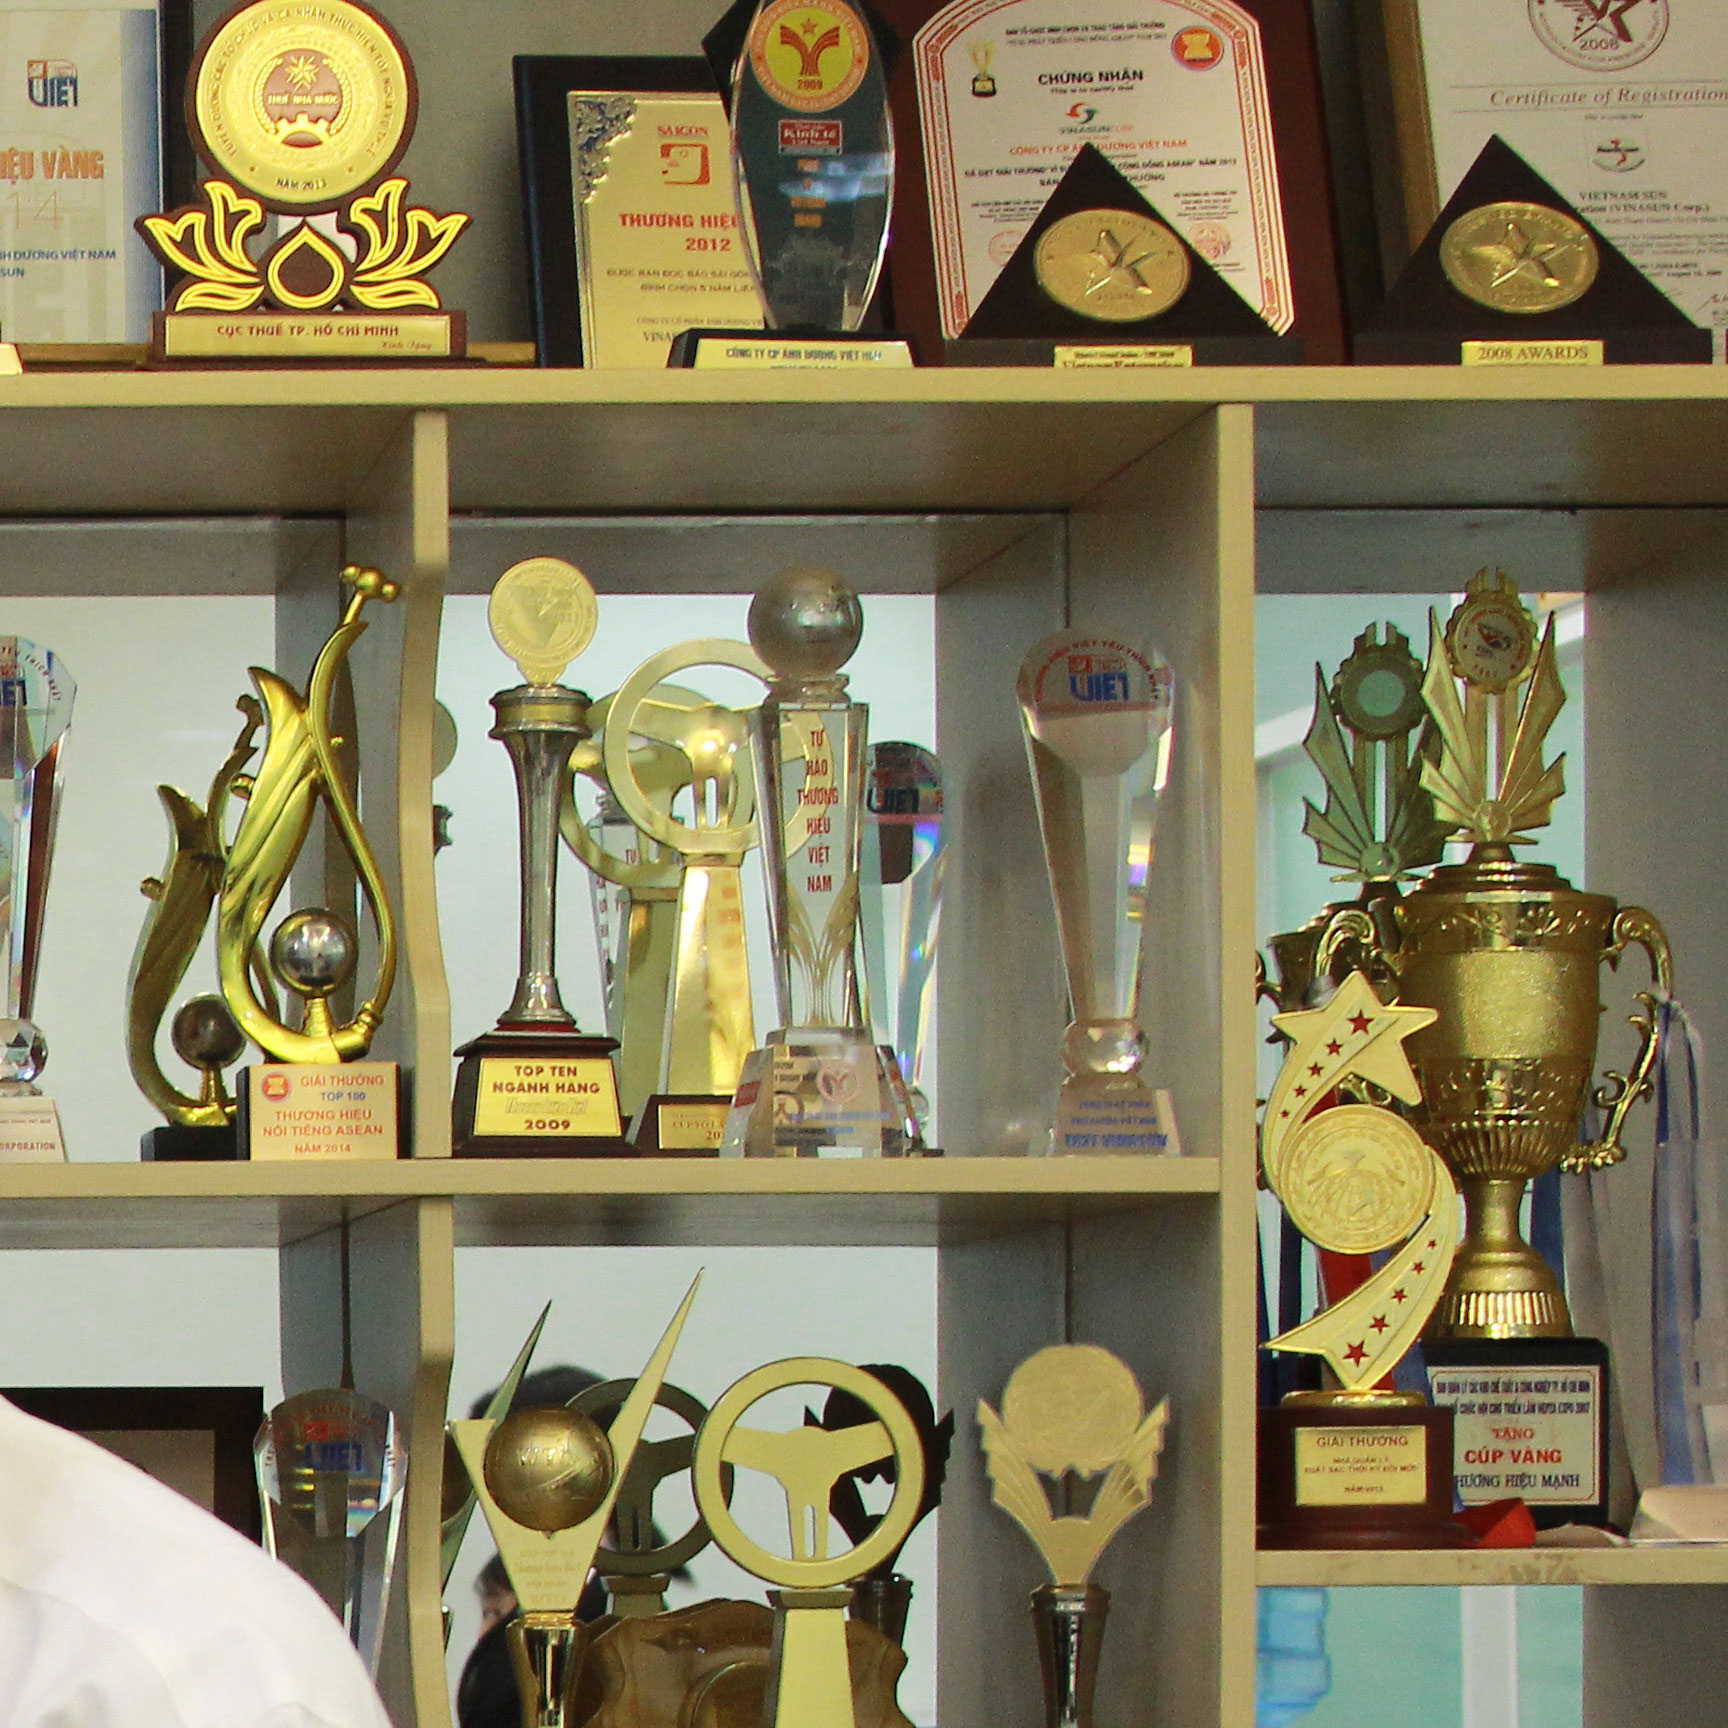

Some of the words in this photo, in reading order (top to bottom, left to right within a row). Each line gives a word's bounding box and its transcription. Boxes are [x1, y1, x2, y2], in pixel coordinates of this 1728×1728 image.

[1580, 39, 1620, 50] 2008
[1038, 71, 1094, 86] CHỨNG
[1491, 89, 1587, 107] Certificate
[1592, 88, 1612, 103] of
[1618, 88, 1728, 106] Registration
[658, 126, 709, 137] SAIGON
[42, 144, 105, 180] VÀNG
[619, 212, 694, 228] THƯƠNG
[685, 238, 731, 251] 2012
[88, 250, 116, 260] NAM
[247, 322, 283, 336] THUẾ
[364, 325, 399, 336] MINH
[1478, 348, 1513, 361] 2008
[1517, 347, 1588, 361] AWARDS
[807, 875, 832, 892] NAM
[514, 1065, 545, 1077] TOP
[550, 1065, 578, 1077] TEN
[320, 1092, 344, 1101] TOP
[275, 1109, 336, 1122] THƯƠNG
[340, 1109, 372, 1122] HIỆU
[290, 1123, 333, 1137] TIẾNG
[336, 1124, 383, 1136] ASEAN
[524, 1119, 572, 1130] 2009
[294, 1142, 322, 1154] NĂM
[324, 1143, 352, 1153] 2014
[1464, 1445, 1504, 1464] CÚP
[1510, 1446, 1562, 1464] VÀNG
[1454, 1473, 1500, 1488] HƯƠNG
[1540, 1474, 1580, 1490] MẠNH
